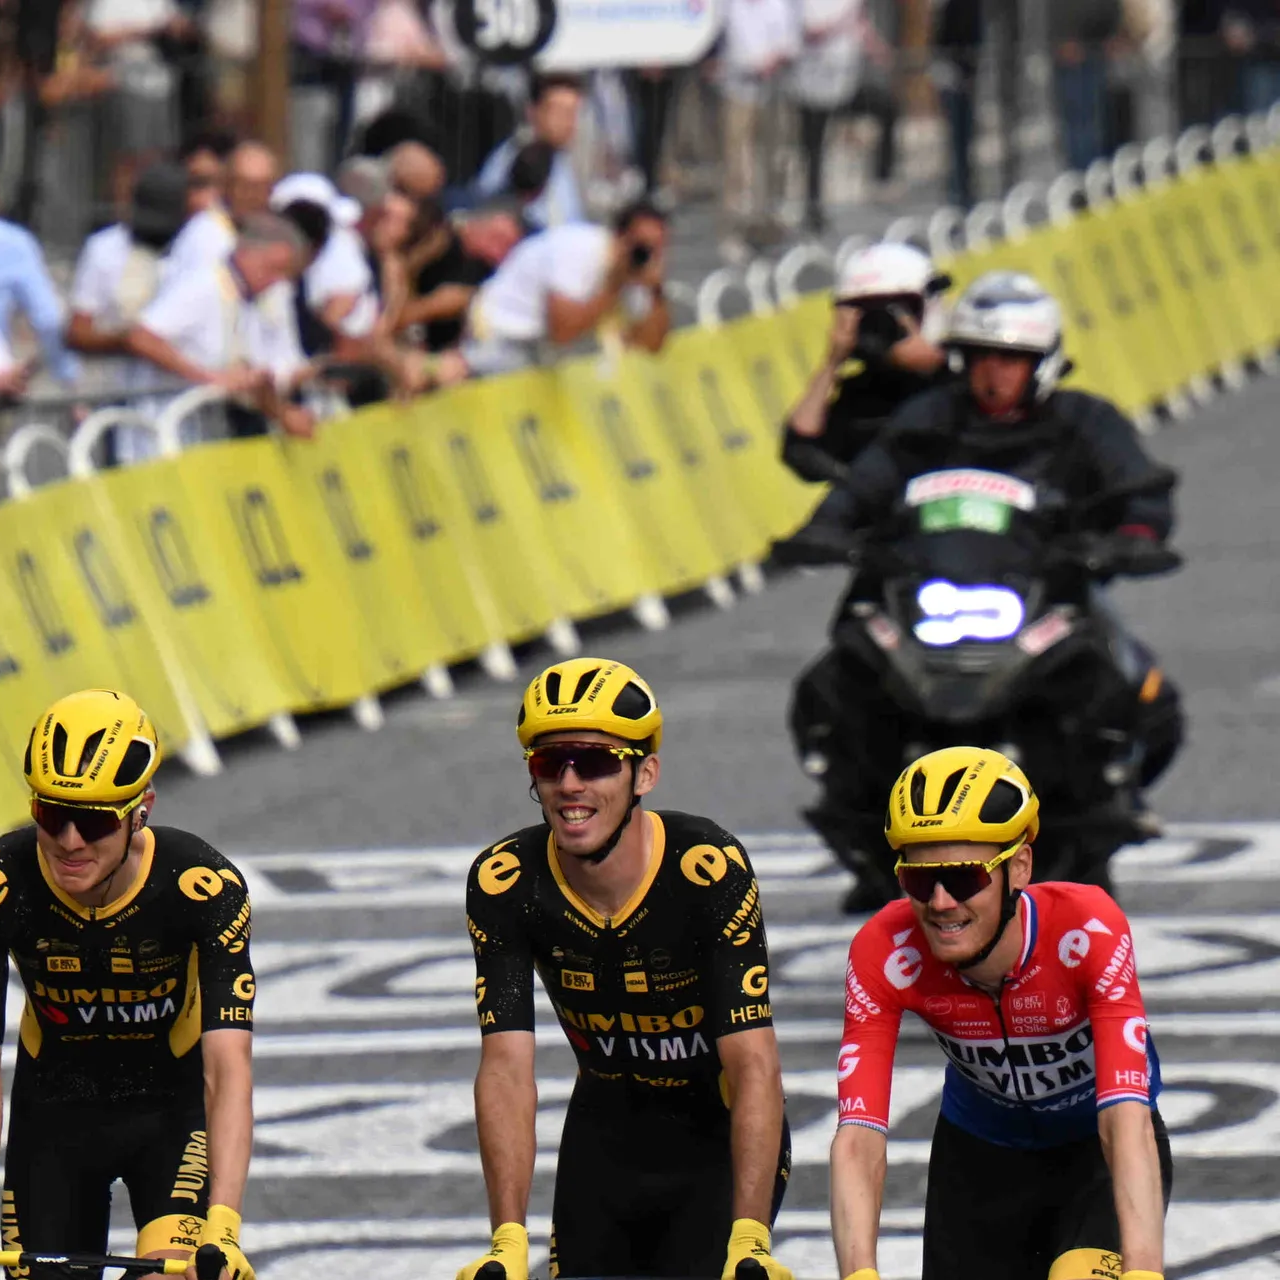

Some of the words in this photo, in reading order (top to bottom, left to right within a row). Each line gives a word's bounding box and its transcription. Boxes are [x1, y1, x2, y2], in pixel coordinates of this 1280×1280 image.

[587, 678, 607, 703] JUMBO
[546, 707, 579, 716] LAZER
[41, 751, 49, 775] VISMA
[89, 749, 109, 782] JUMBO
[52, 779, 84, 789] LAZER
[951, 784, 971, 816] JUMBO
[911, 819, 943, 828] LAZER
[49, 903, 84, 929] JUMBO
[116, 904, 140, 922] VISMA
[563, 909, 599, 939] JUMBO
[628, 907, 650, 930] VISMA
[622, 959, 644, 968] AGU
[1095, 934, 1131, 996] JUMBO
[233, 972, 255, 1001] G
[574, 973, 588, 982] BET
[574, 979, 592, 988] CITY
[626, 978, 646, 986] HEMA
[741, 964, 768, 997] G
[1019, 965, 1042, 988] VISMA
[34, 977, 178, 1004] JUMBO
[78, 997, 176, 1025] VISMA
[559, 1004, 705, 1034] JUMBO
[1012, 1015, 1047, 1025] lease
[1054, 1011, 1078, 1026] AGU
[596, 1031, 710, 1061] VISMA
[991, 1057, 1093, 1096] VISM
[170, 1130, 208, 1204] JUMBO
